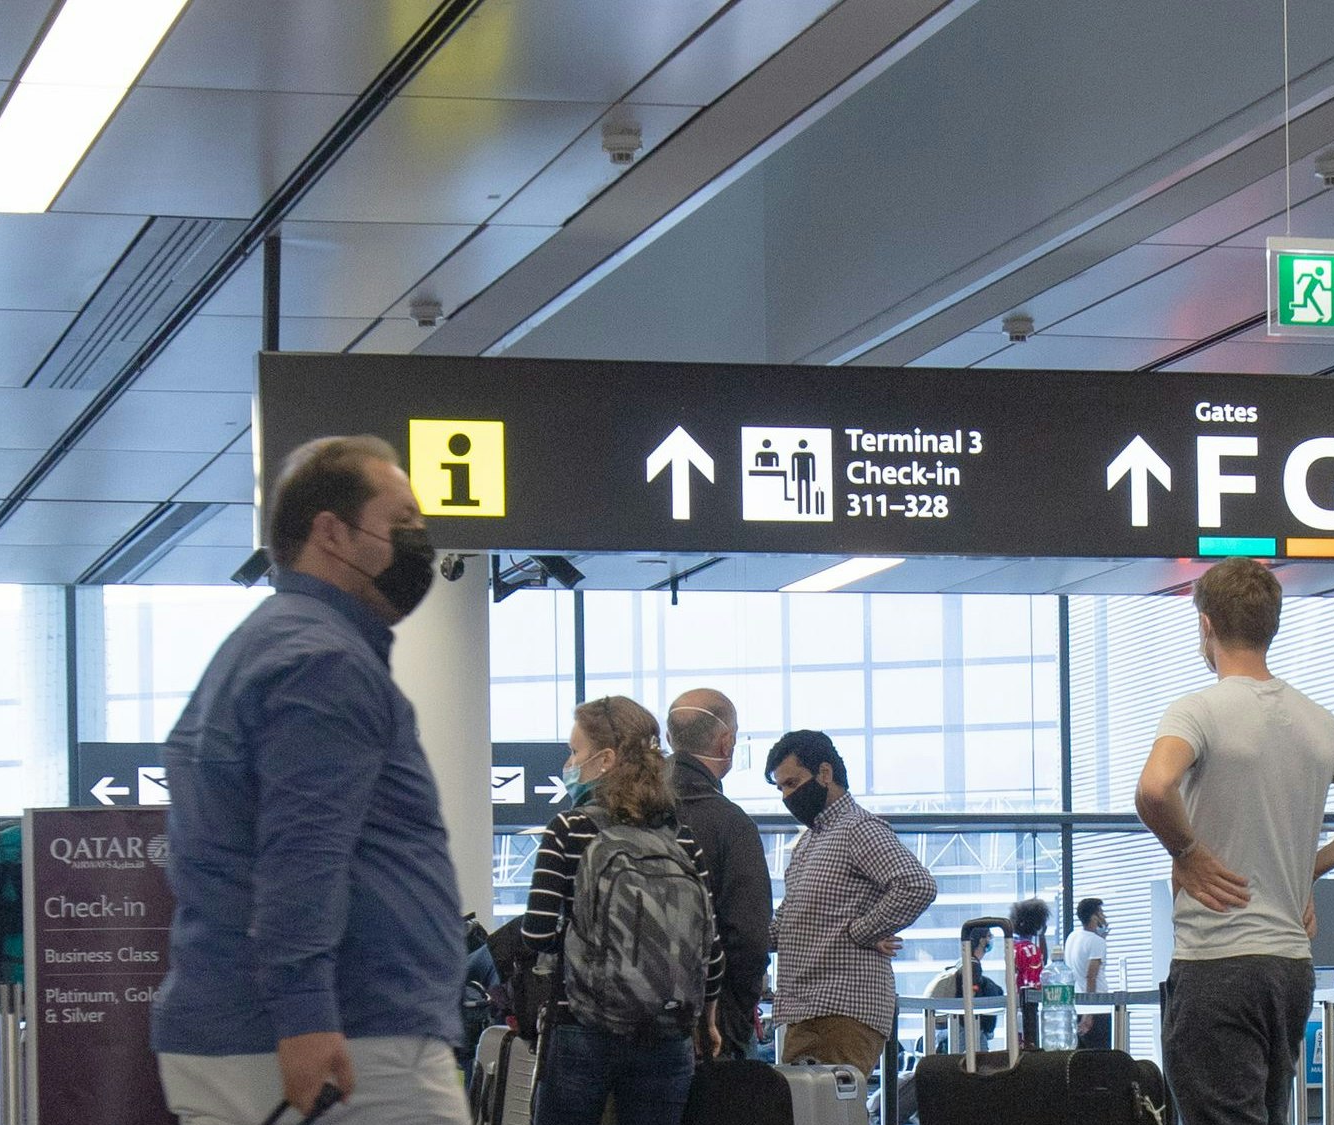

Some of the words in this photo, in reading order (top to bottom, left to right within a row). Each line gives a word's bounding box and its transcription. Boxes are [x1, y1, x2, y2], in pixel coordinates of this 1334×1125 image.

[1195, 402, 1258, 422] Gates
[844, 427, 962, 453] Terminal
[968, 430, 983, 454] 3
[846, 460, 960, 486] Check-in
[1196, 435, 1259, 528] F
[846, 493, 949, 518] 311–328
[50, 837, 145, 863] QATAR
[44, 895, 145, 918] Check-in
[45, 949, 112, 963] Business
[117, 947, 160, 962] Class
[45, 988, 119, 1004] Platinum,
[45, 1009, 57, 1023] &
[62, 1008, 106, 1023] Silver
